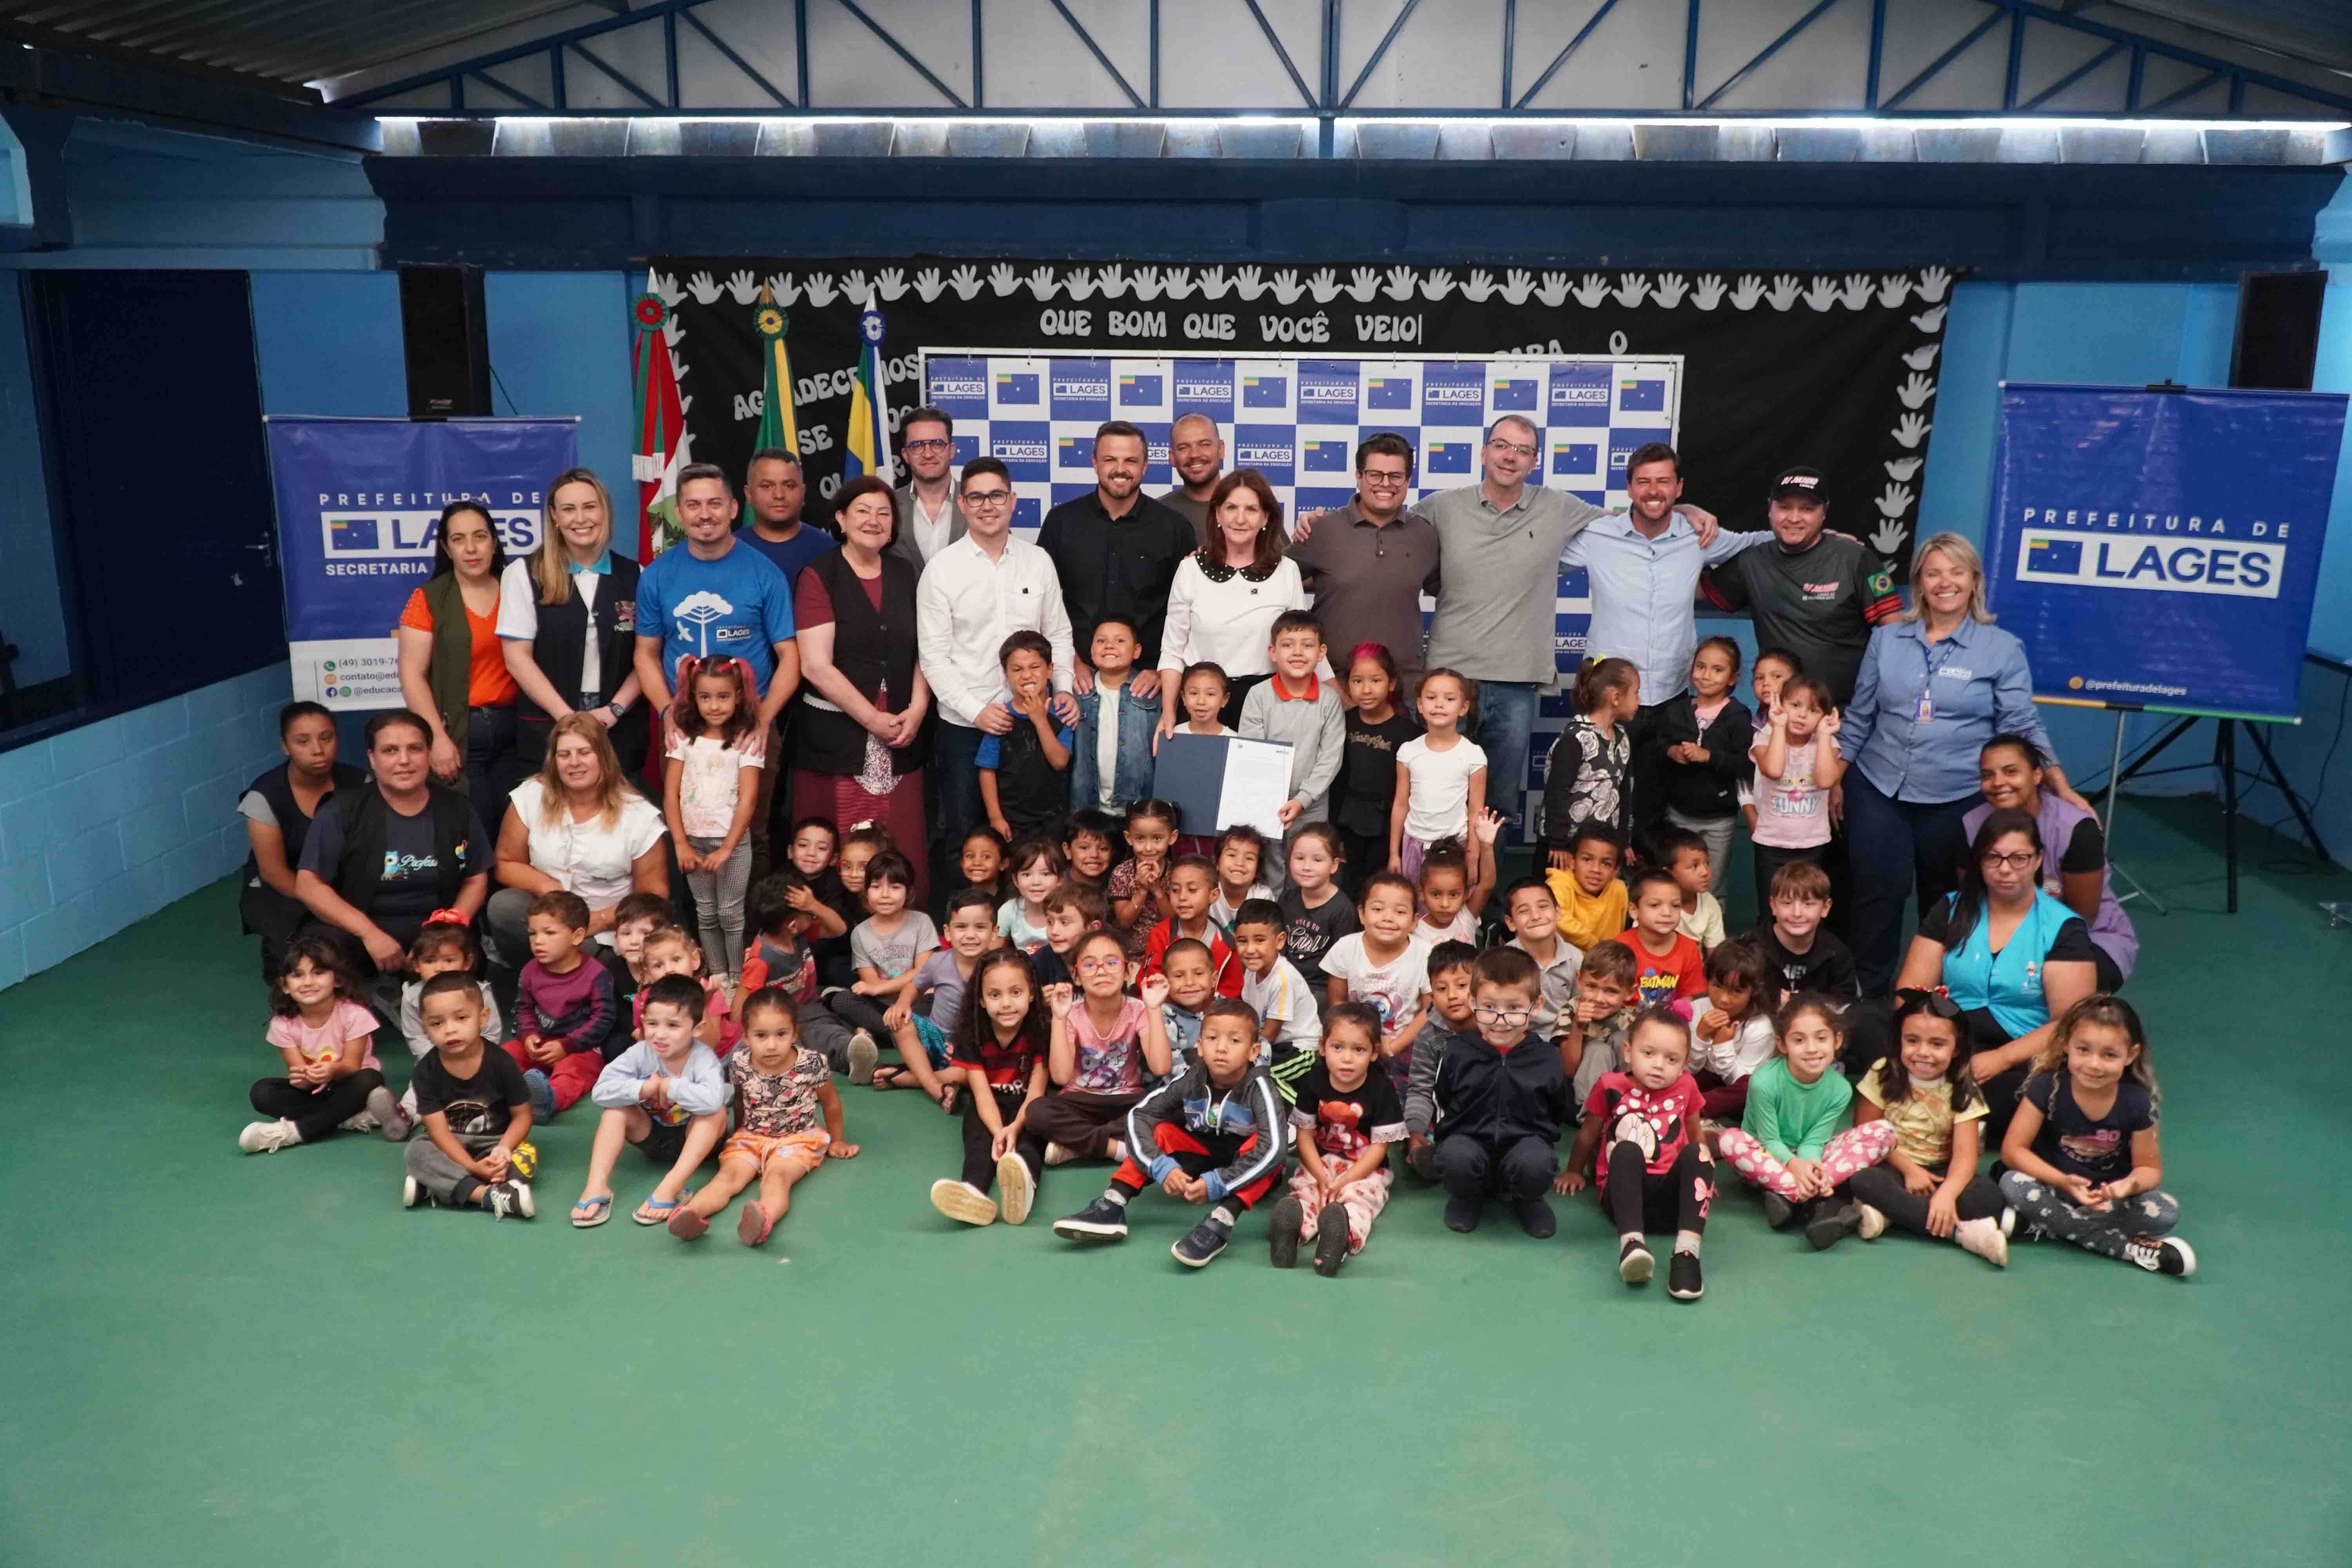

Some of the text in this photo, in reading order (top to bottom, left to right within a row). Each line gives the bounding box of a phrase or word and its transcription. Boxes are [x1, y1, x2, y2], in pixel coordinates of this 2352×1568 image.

[1040, 309, 1091, 336] QUE
[1109, 311, 1167, 338] BOM
[1183, 313, 1236, 340] QUE
[1259, 310, 1330, 343] VOCÊ
[947, 383, 983, 392] LAGES
[1070, 385, 1105, 394] LAGES
[1194, 387, 1229, 395] LAGES
[1318, 388, 1353, 397] LAGES
[1443, 390, 1479, 399] LAGES
[1569, 390, 1605, 399] LAGES
[1010, 447, 1044, 456] LAGES
[1148, 449, 1167, 457] GES
[1255, 451, 1290, 459] LAGES
[512, 492, 539, 504] DE
[2024, 508, 2290, 538] PREFEITURA DE
[326, 562, 427, 576] SECRETARIA
[2096, 543, 2271, 588] LAGES
[339, 659, 358, 668] (49)
[2085, 679, 2187, 696] @prefeituradelages
[1640, 974, 1680, 989] BATMAN
